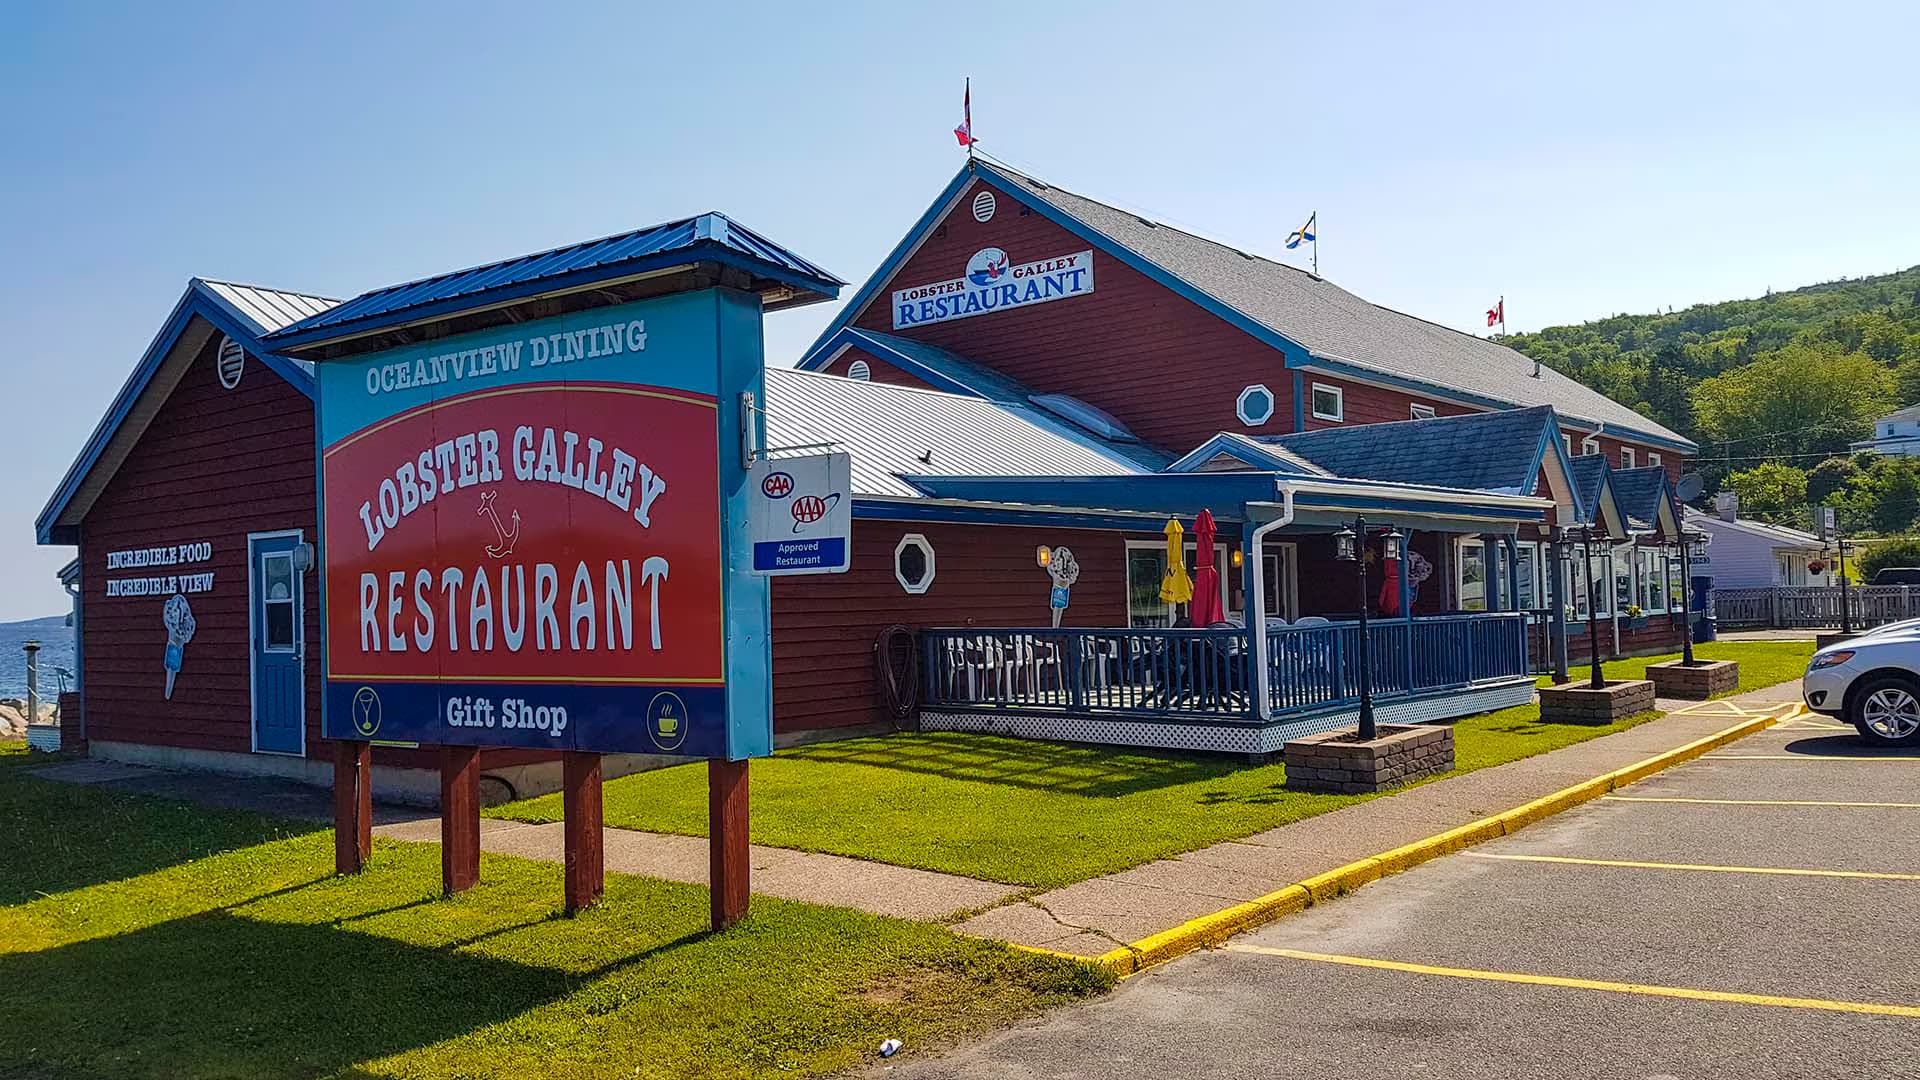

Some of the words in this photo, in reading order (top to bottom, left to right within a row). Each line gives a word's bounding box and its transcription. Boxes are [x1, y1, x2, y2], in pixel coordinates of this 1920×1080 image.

[902, 281, 966, 302] LOBSTER
[1012, 256, 1078, 279] GALLEY
[898, 268, 1087, 325] RESTAURANT
[366, 341, 524, 395] OCEANVIEW
[529, 320, 648, 367] DINING
[359, 429, 503, 550] LOBSTER
[512, 425, 666, 528] GALLEY
[765, 475, 790, 495] CAA
[794, 496, 823, 521] AAA
[106, 547, 177, 569] INCREDIBLE
[178, 542, 212, 563] FOOD
[776, 555, 821, 566] Restaurant
[778, 541, 819, 554] Approved
[106, 576, 177, 597] INCREDIBLE
[179, 573, 215, 593] VIEW
[360, 556, 669, 652] RESTAURANT
[446, 696, 495, 728] Gift
[501, 698, 567, 737] Shop
